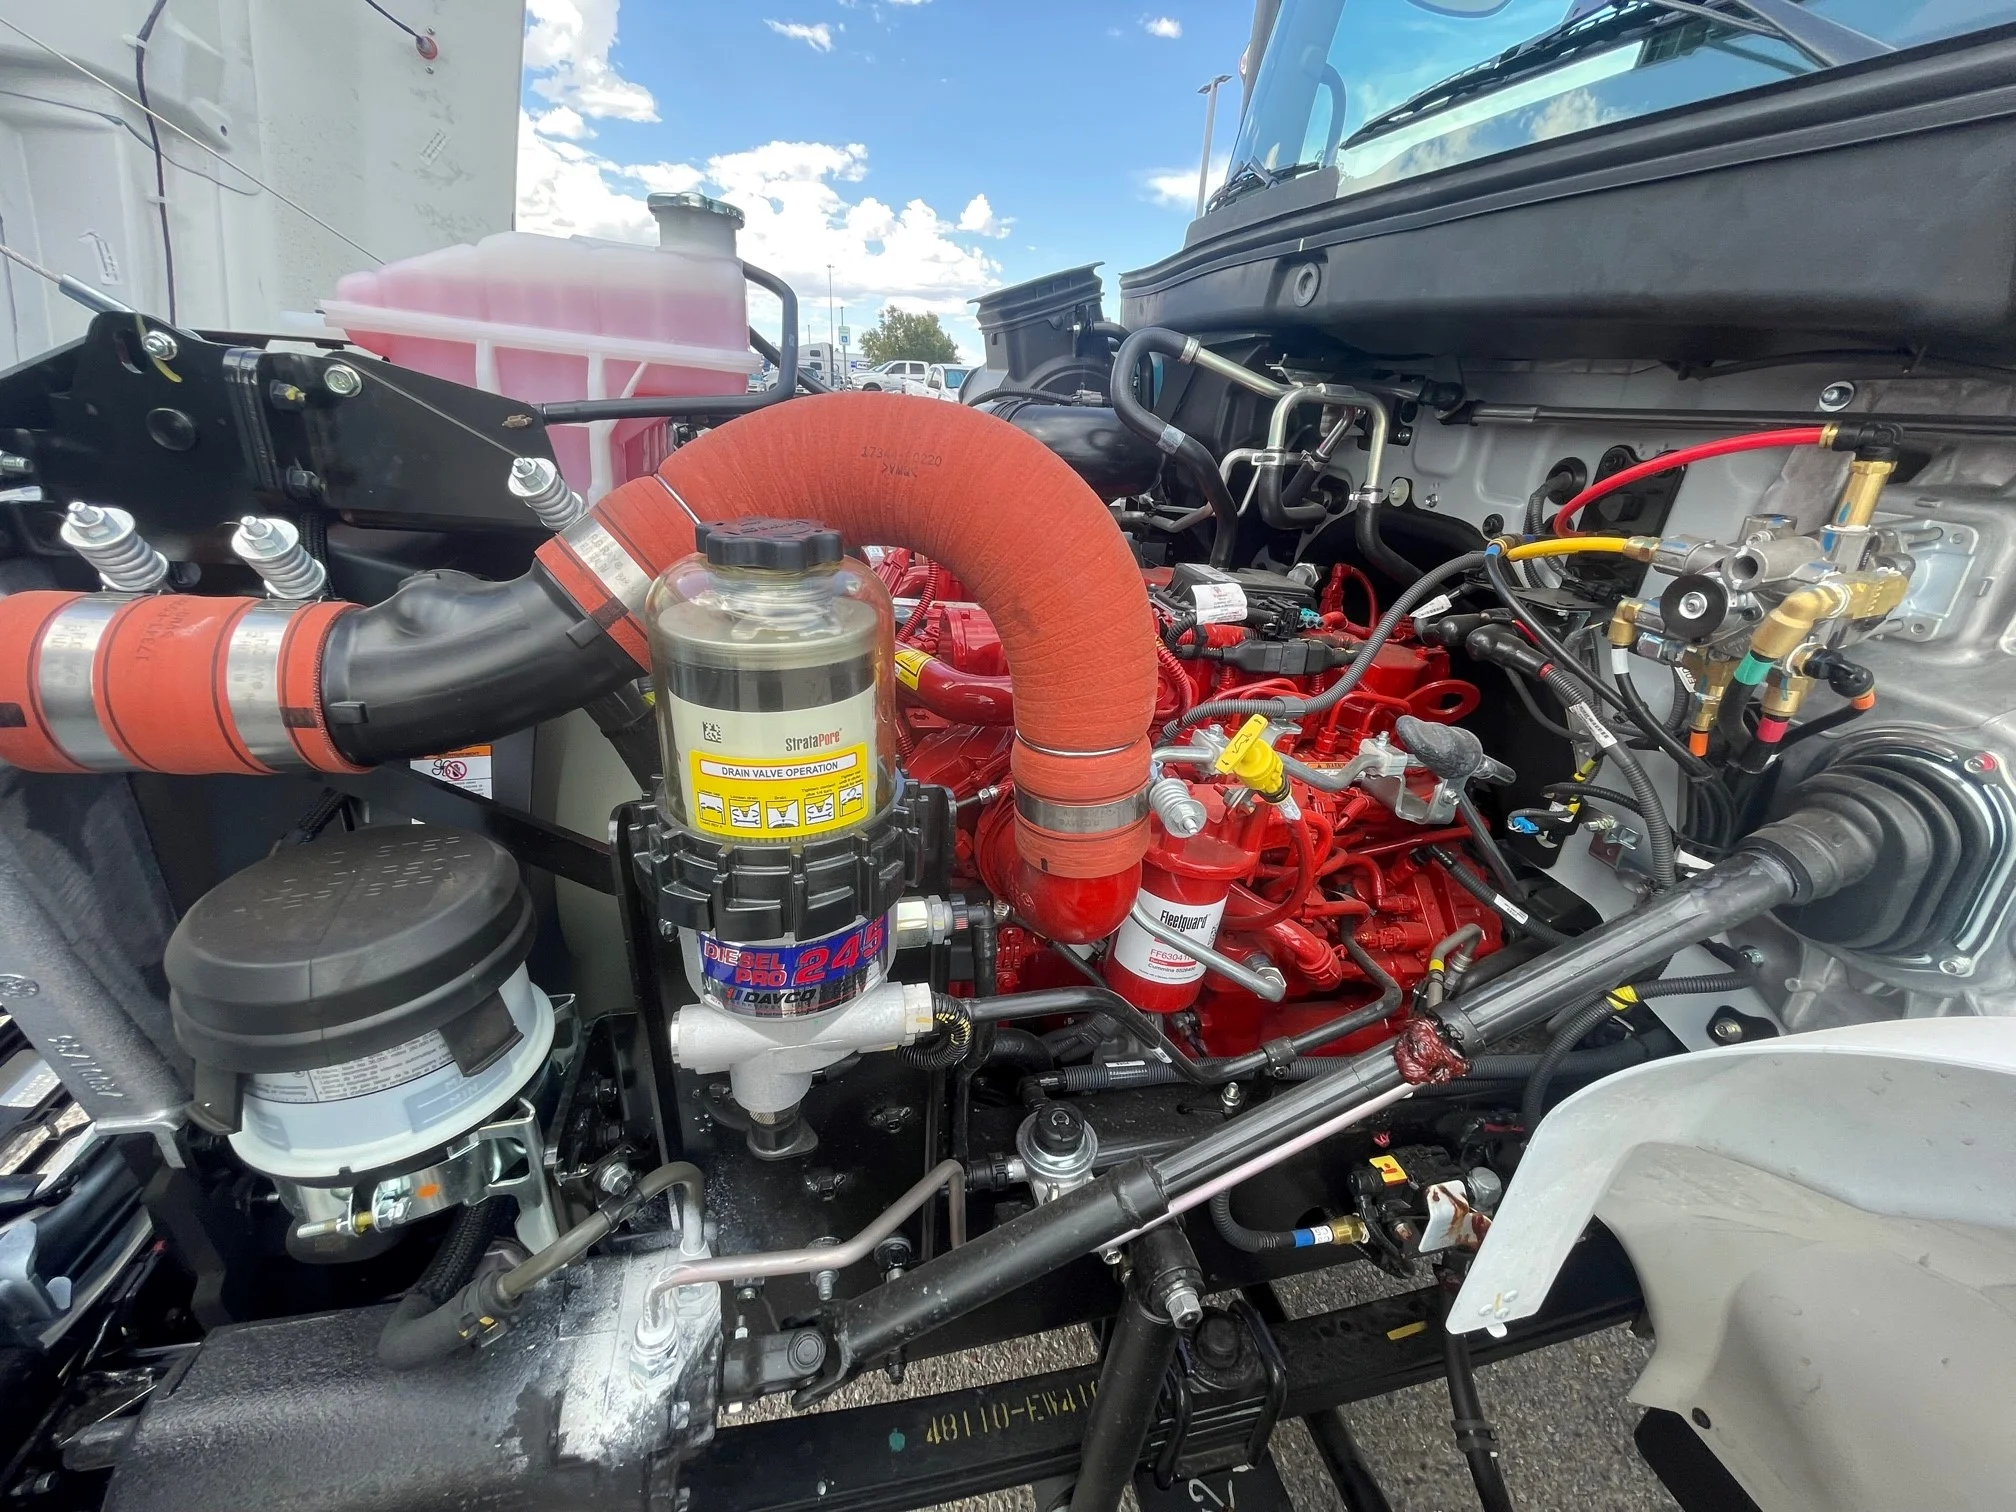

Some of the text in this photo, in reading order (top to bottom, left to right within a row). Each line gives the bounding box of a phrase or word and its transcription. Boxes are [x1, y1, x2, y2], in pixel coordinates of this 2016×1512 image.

[721, 760, 838, 778] DRAIN VALVE OPERATION
[376, 836, 460, 858] STEP
[1160, 909, 1207, 933] Fleetguard
[703, 939, 786, 971] DIESEL
[793, 914, 885, 986] 245
[1150, 948, 1193, 962] FF63041
[735, 967, 788, 987] PRO
[1147, 963, 1175, 973] Cummins
[743, 987, 818, 1007] DAVCO
